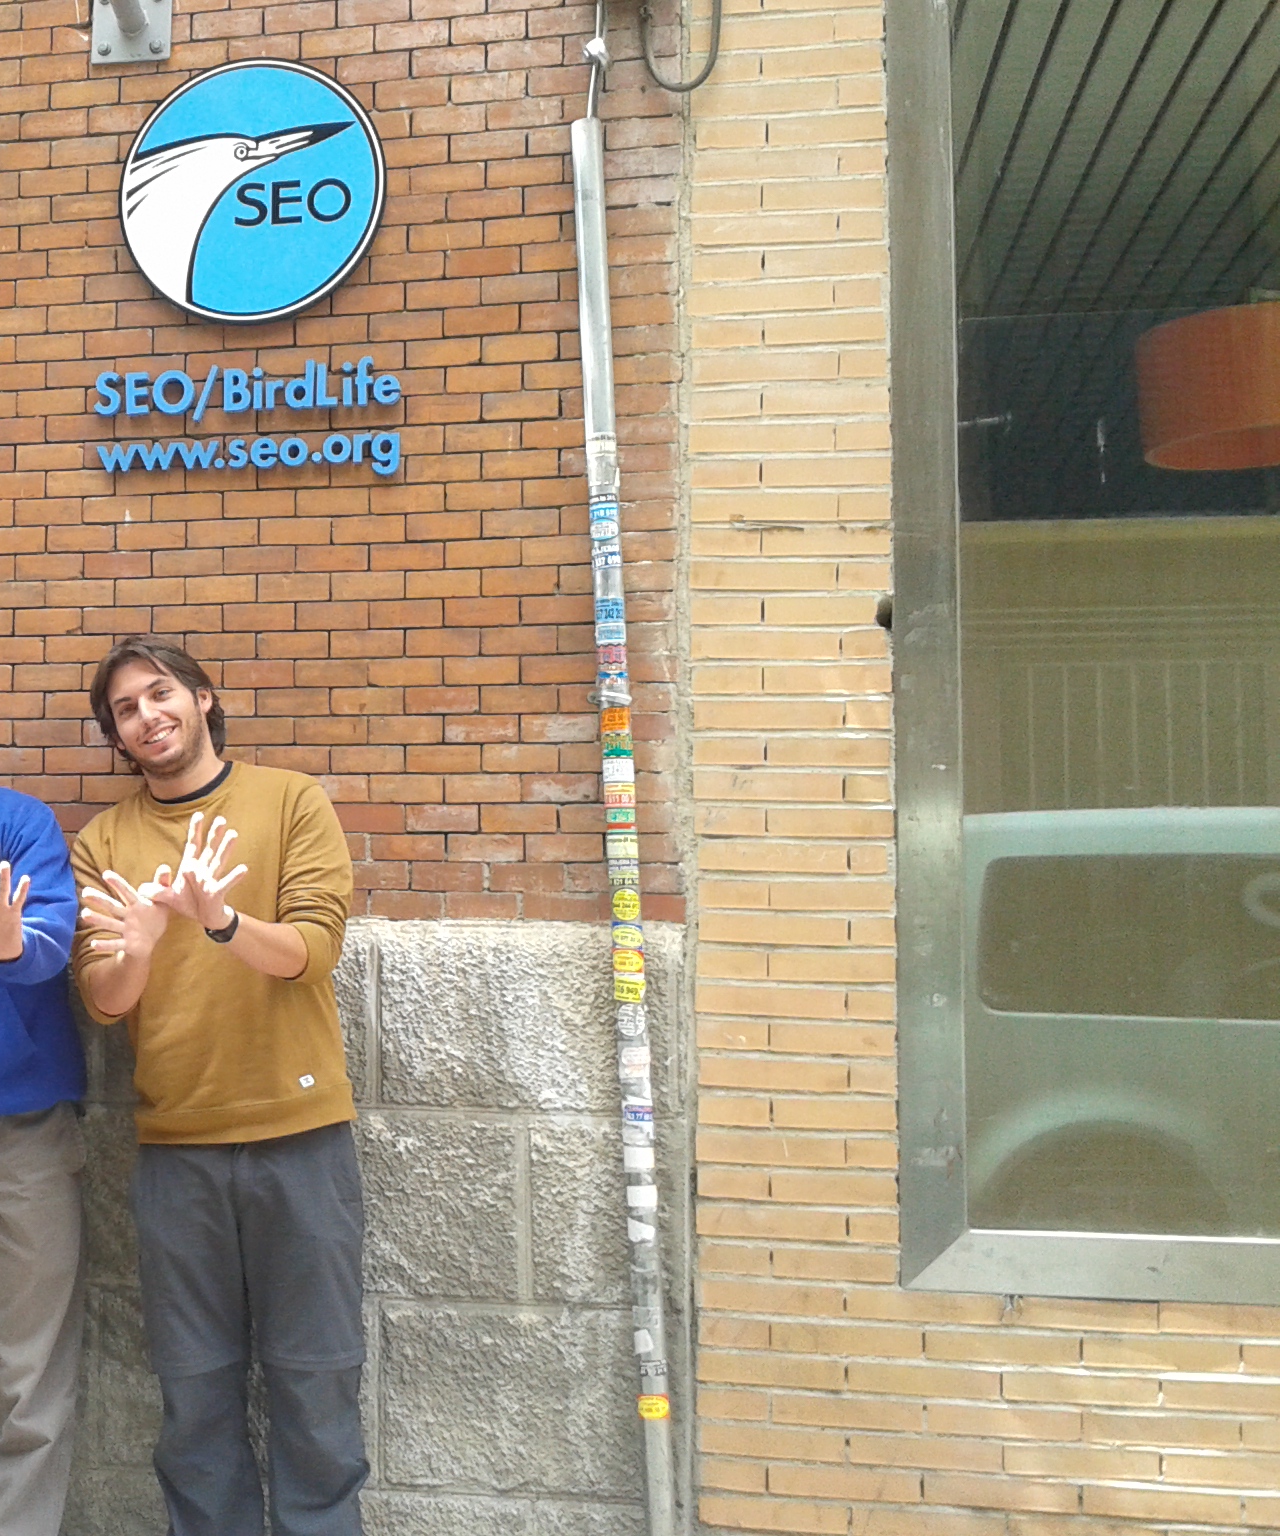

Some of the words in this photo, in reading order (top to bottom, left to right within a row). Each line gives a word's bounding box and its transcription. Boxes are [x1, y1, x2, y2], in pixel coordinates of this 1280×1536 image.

[233, 178, 352, 227] SEO
[93, 355, 402, 422] SEO/BirdLife
[96, 432, 401, 475] www.seo.org
